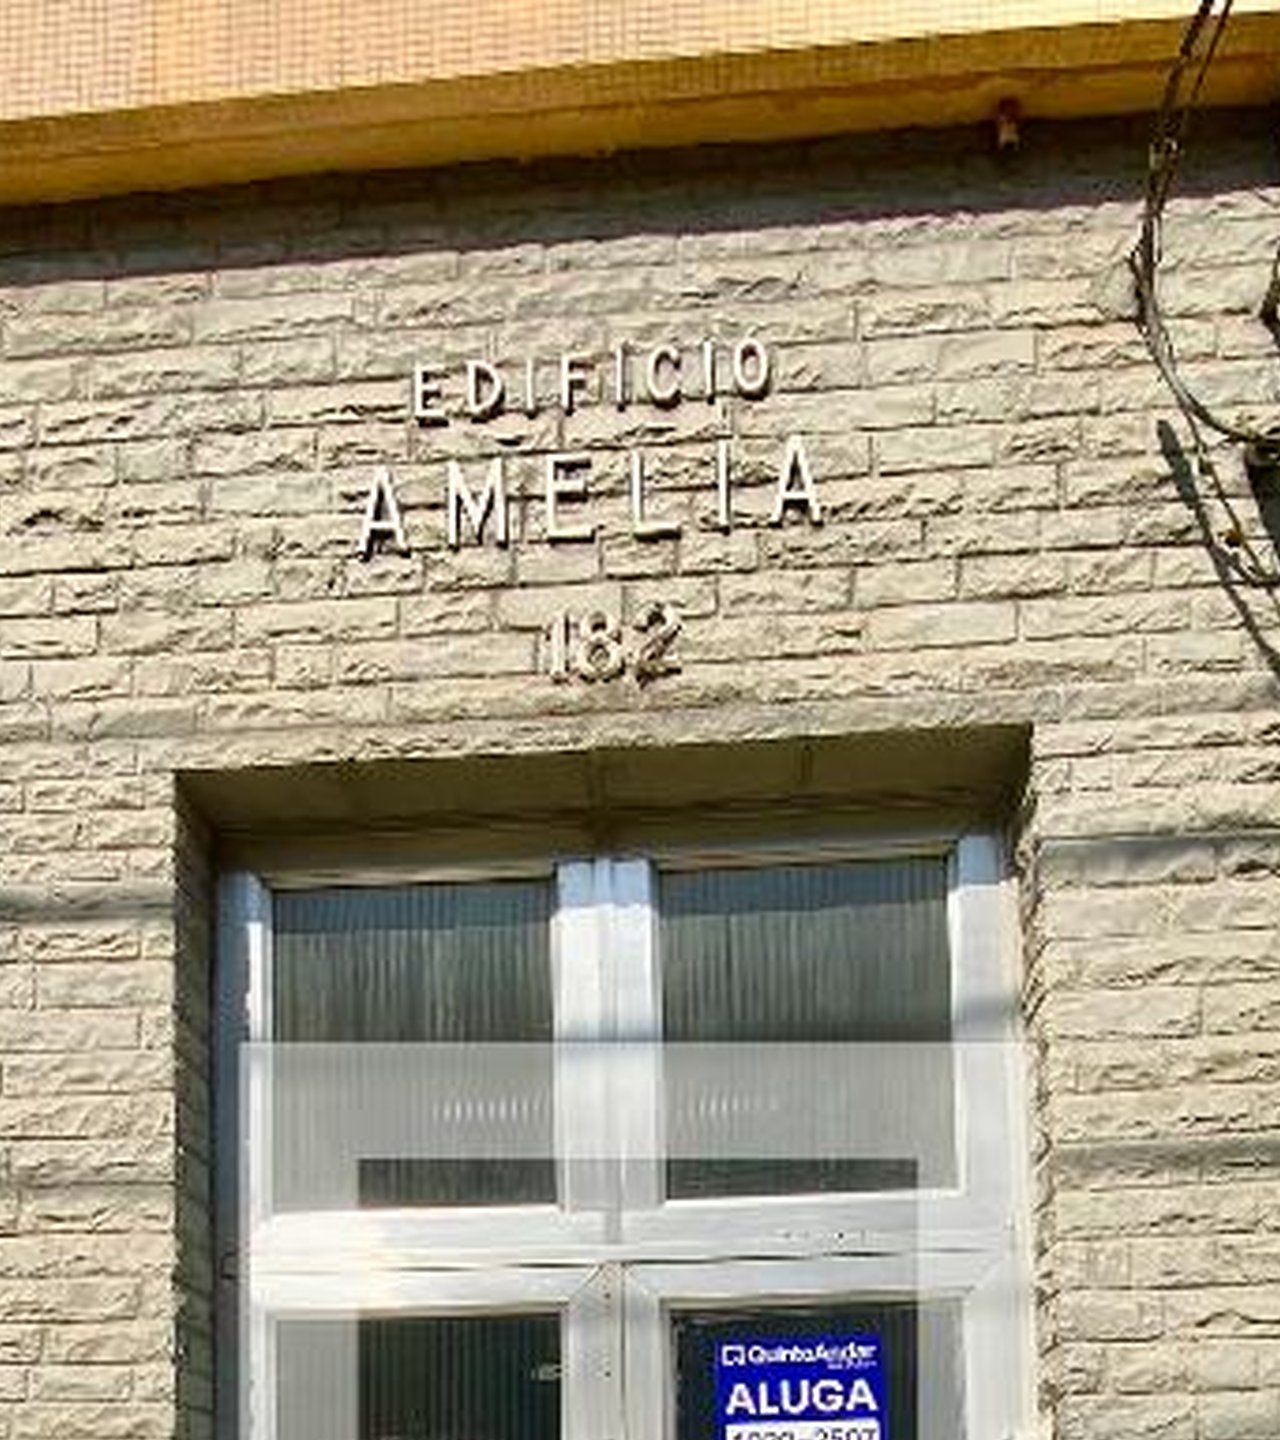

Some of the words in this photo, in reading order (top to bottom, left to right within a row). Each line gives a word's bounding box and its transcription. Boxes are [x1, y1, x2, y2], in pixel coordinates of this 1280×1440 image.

[413, 336, 772, 420] EDIFICIO
[358, 435, 823, 558] AMELIA
[548, 602, 682, 683] 182
[725, 1377, 879, 1415] ALUGA
